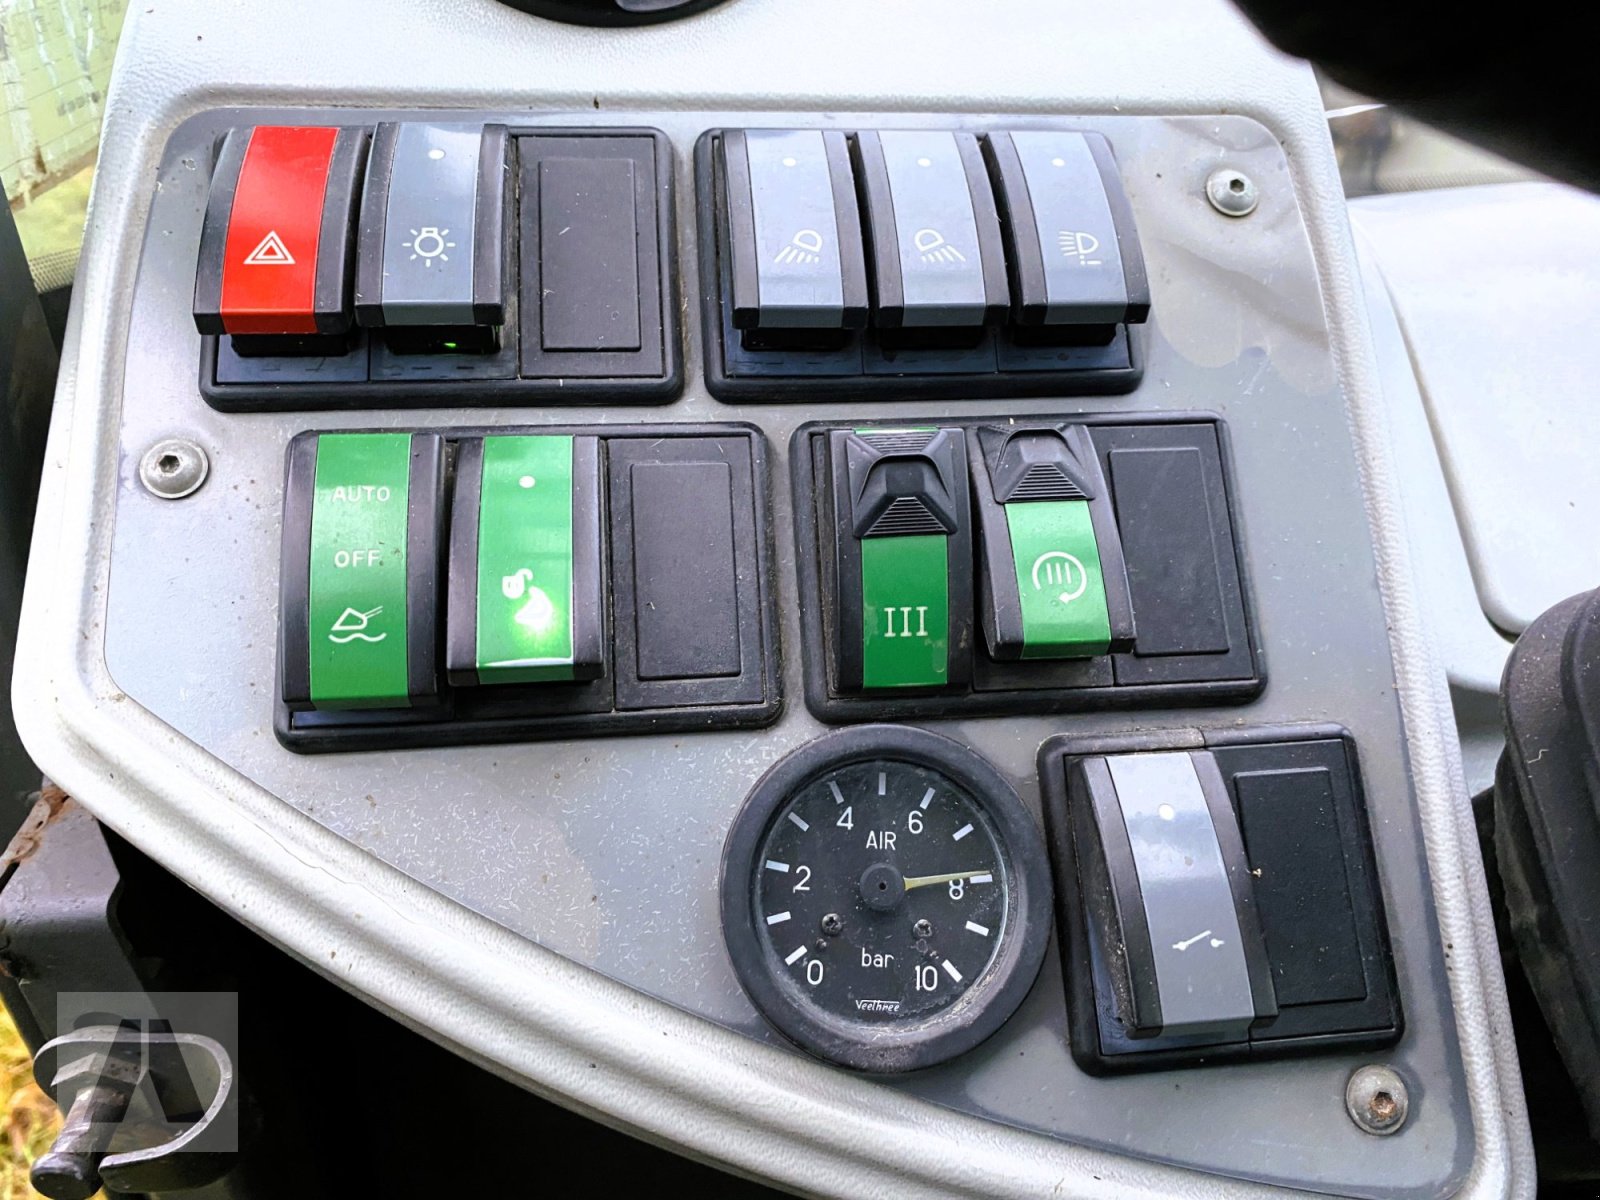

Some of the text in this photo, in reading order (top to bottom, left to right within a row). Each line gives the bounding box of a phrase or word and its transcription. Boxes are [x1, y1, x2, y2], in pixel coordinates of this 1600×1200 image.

[331, 486, 391, 503] AUTO
[333, 549, 380, 567] OFF
[884, 606, 928, 637] III
[836, 806, 854, 830] 4
[907, 810, 924, 834] 6
[865, 831, 897, 850] AIR
[792, 865, 811, 892] 2
[948, 877, 964, 900] 8
[861, 947, 894, 968] bar
[806, 959, 823, 985] 0
[914, 964, 938, 991] 10
[855, 999, 900, 1012] Veethree
